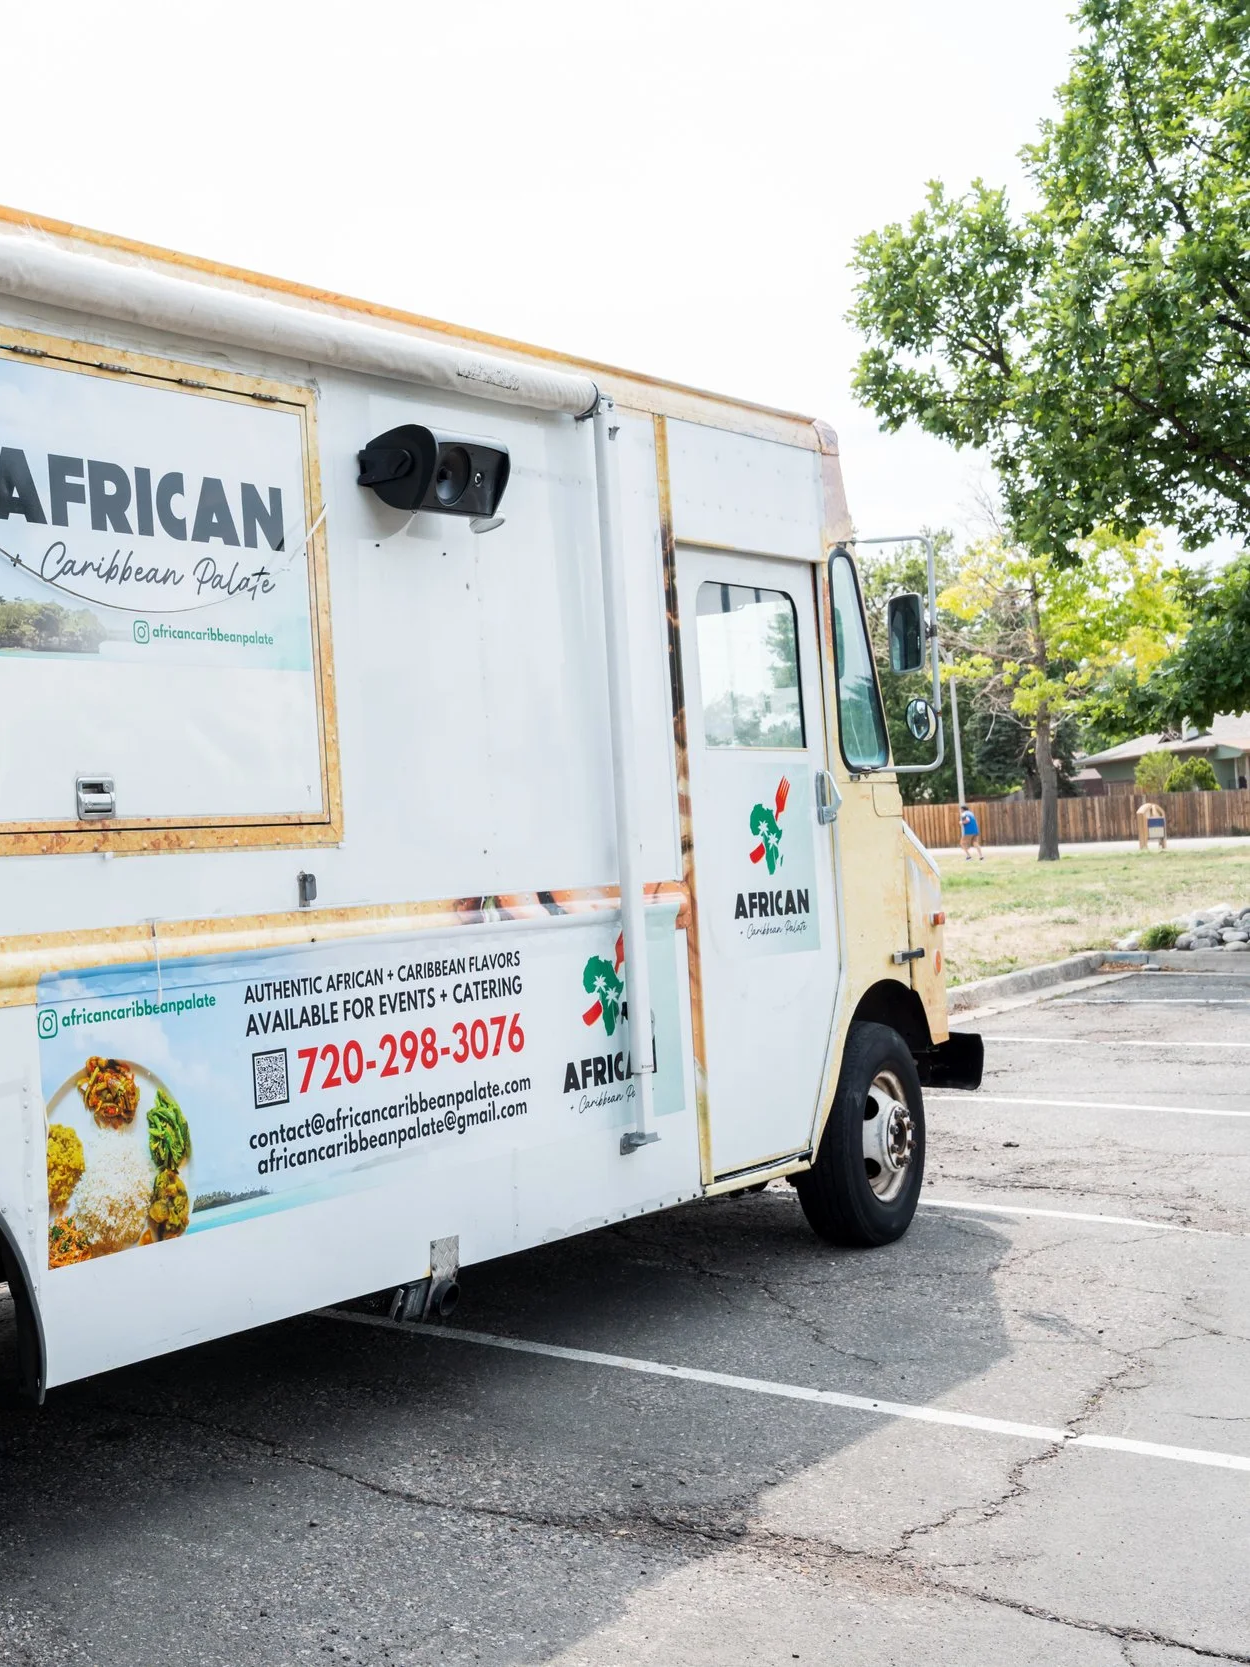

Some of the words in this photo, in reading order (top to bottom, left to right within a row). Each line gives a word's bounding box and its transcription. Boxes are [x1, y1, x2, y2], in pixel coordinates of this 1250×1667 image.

[40, 541, 184, 585] Caribbean
[193, 557, 276, 600] Palate
[152, 624, 274, 647] africancaribbeanpalate
[734, 888, 810, 920] AFRICAN
[746, 923, 783, 940] Caribbean
[784, 919, 808, 936] Palate
[244, 975, 323, 1004] AUTHENTIC
[326, 968, 384, 993] AFRICAN
[387, 970, 394, 981] +
[397, 957, 466, 983] CARIBBEAN
[469, 950, 521, 973] FLAVORS
[61, 993, 216, 1028] africancaribbeanpalate
[245, 1001, 339, 1037] AVAILABLE
[343, 998, 376, 1021] FOR
[379, 988, 436, 1016] EVENTS
[440, 991, 448, 1002] +
[452, 975, 523, 1004] CATERING
[297, 1012, 525, 1094] 720-298-3076
[249, 1076, 531, 1150] contact@africancaribbeanpalate.com
[578, 1091, 623, 1114] Caribbean
[257, 1099, 528, 1175] africancaribbeanpalate@gmail.com
